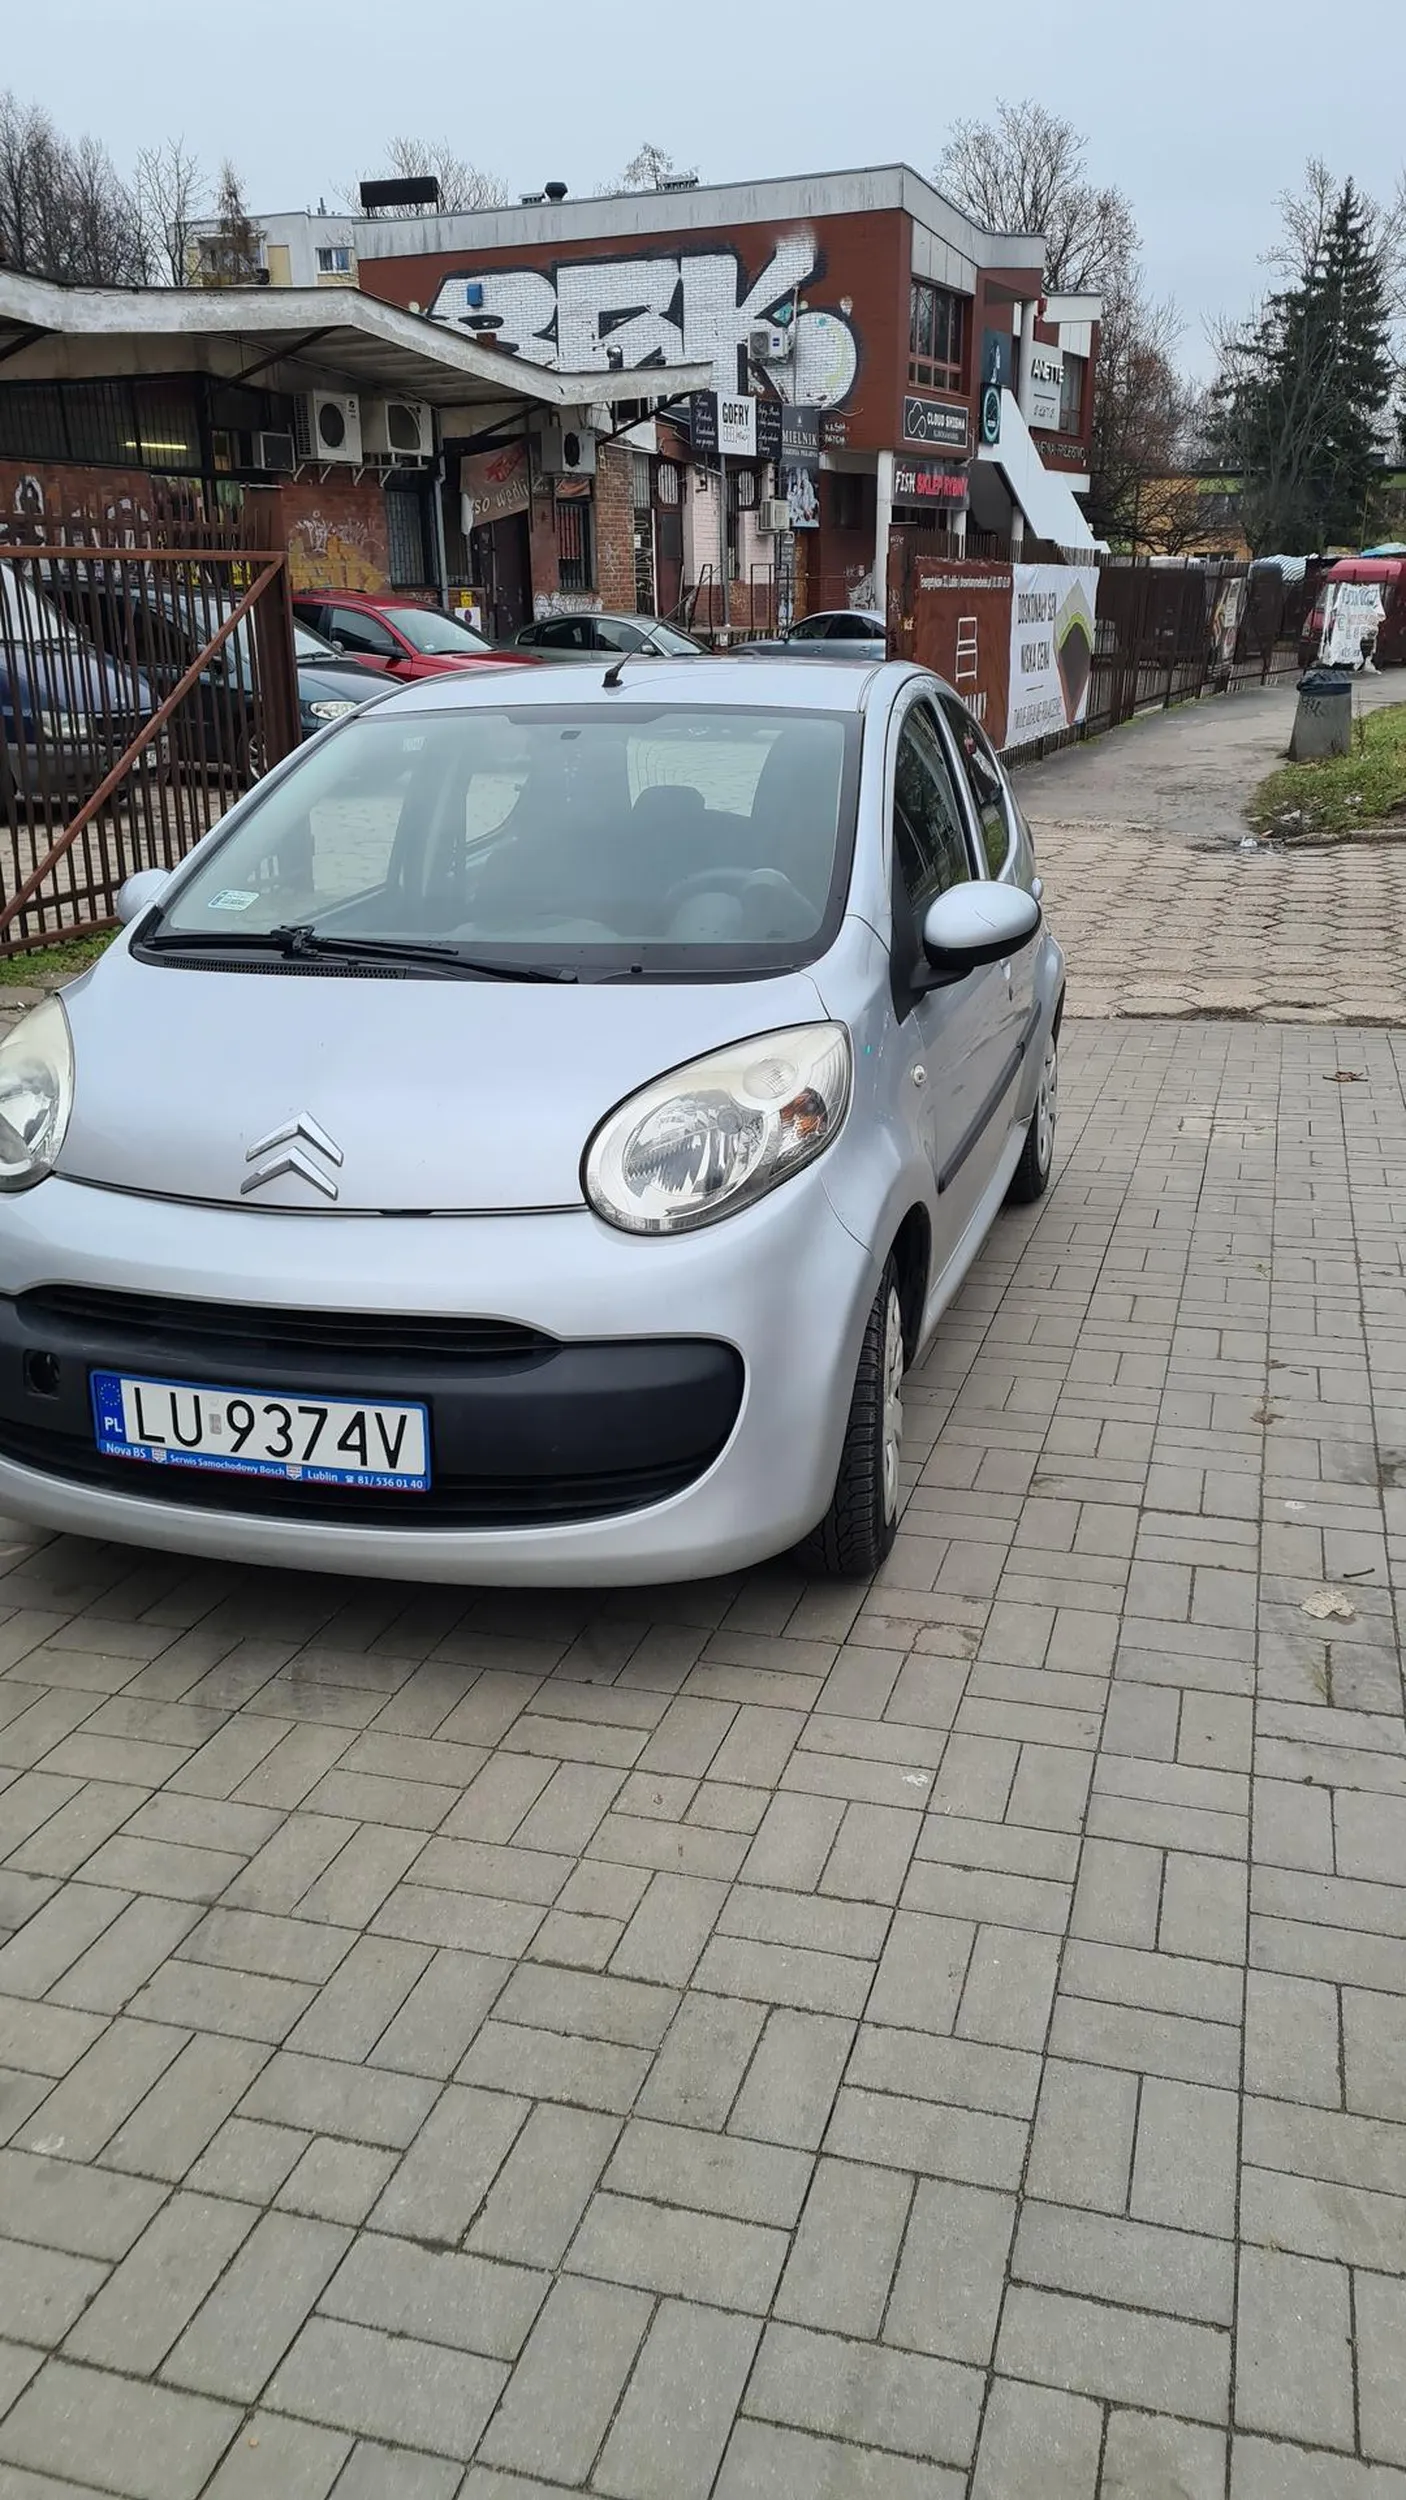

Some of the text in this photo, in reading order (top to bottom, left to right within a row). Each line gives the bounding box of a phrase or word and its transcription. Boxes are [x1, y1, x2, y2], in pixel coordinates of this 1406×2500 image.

[722, 402, 749, 426] GOFRY
[927, 411, 966, 430] CLOUD SHISHA
[782, 429, 818, 446] MIELNIK
[894, 470, 969, 497] FISH SKLEP RYBNY
[104, 1416, 123, 1433] PL
[134, 1387, 408, 1469] LU 9374V
[106, 1443, 131, 1457] Nova
[133, 1448, 147, 1459] BS
[170, 1455, 197, 1466] Serwis
[199, 1458, 258, 1474] Samochodowy
[259, 1464, 285, 1476] Bosch
[307, 1470, 338, 1482] Lublin
[376, 1477, 394, 1488] 536
[396, 1477, 408, 1488] 01
[410, 1478, 423, 1489] 40
